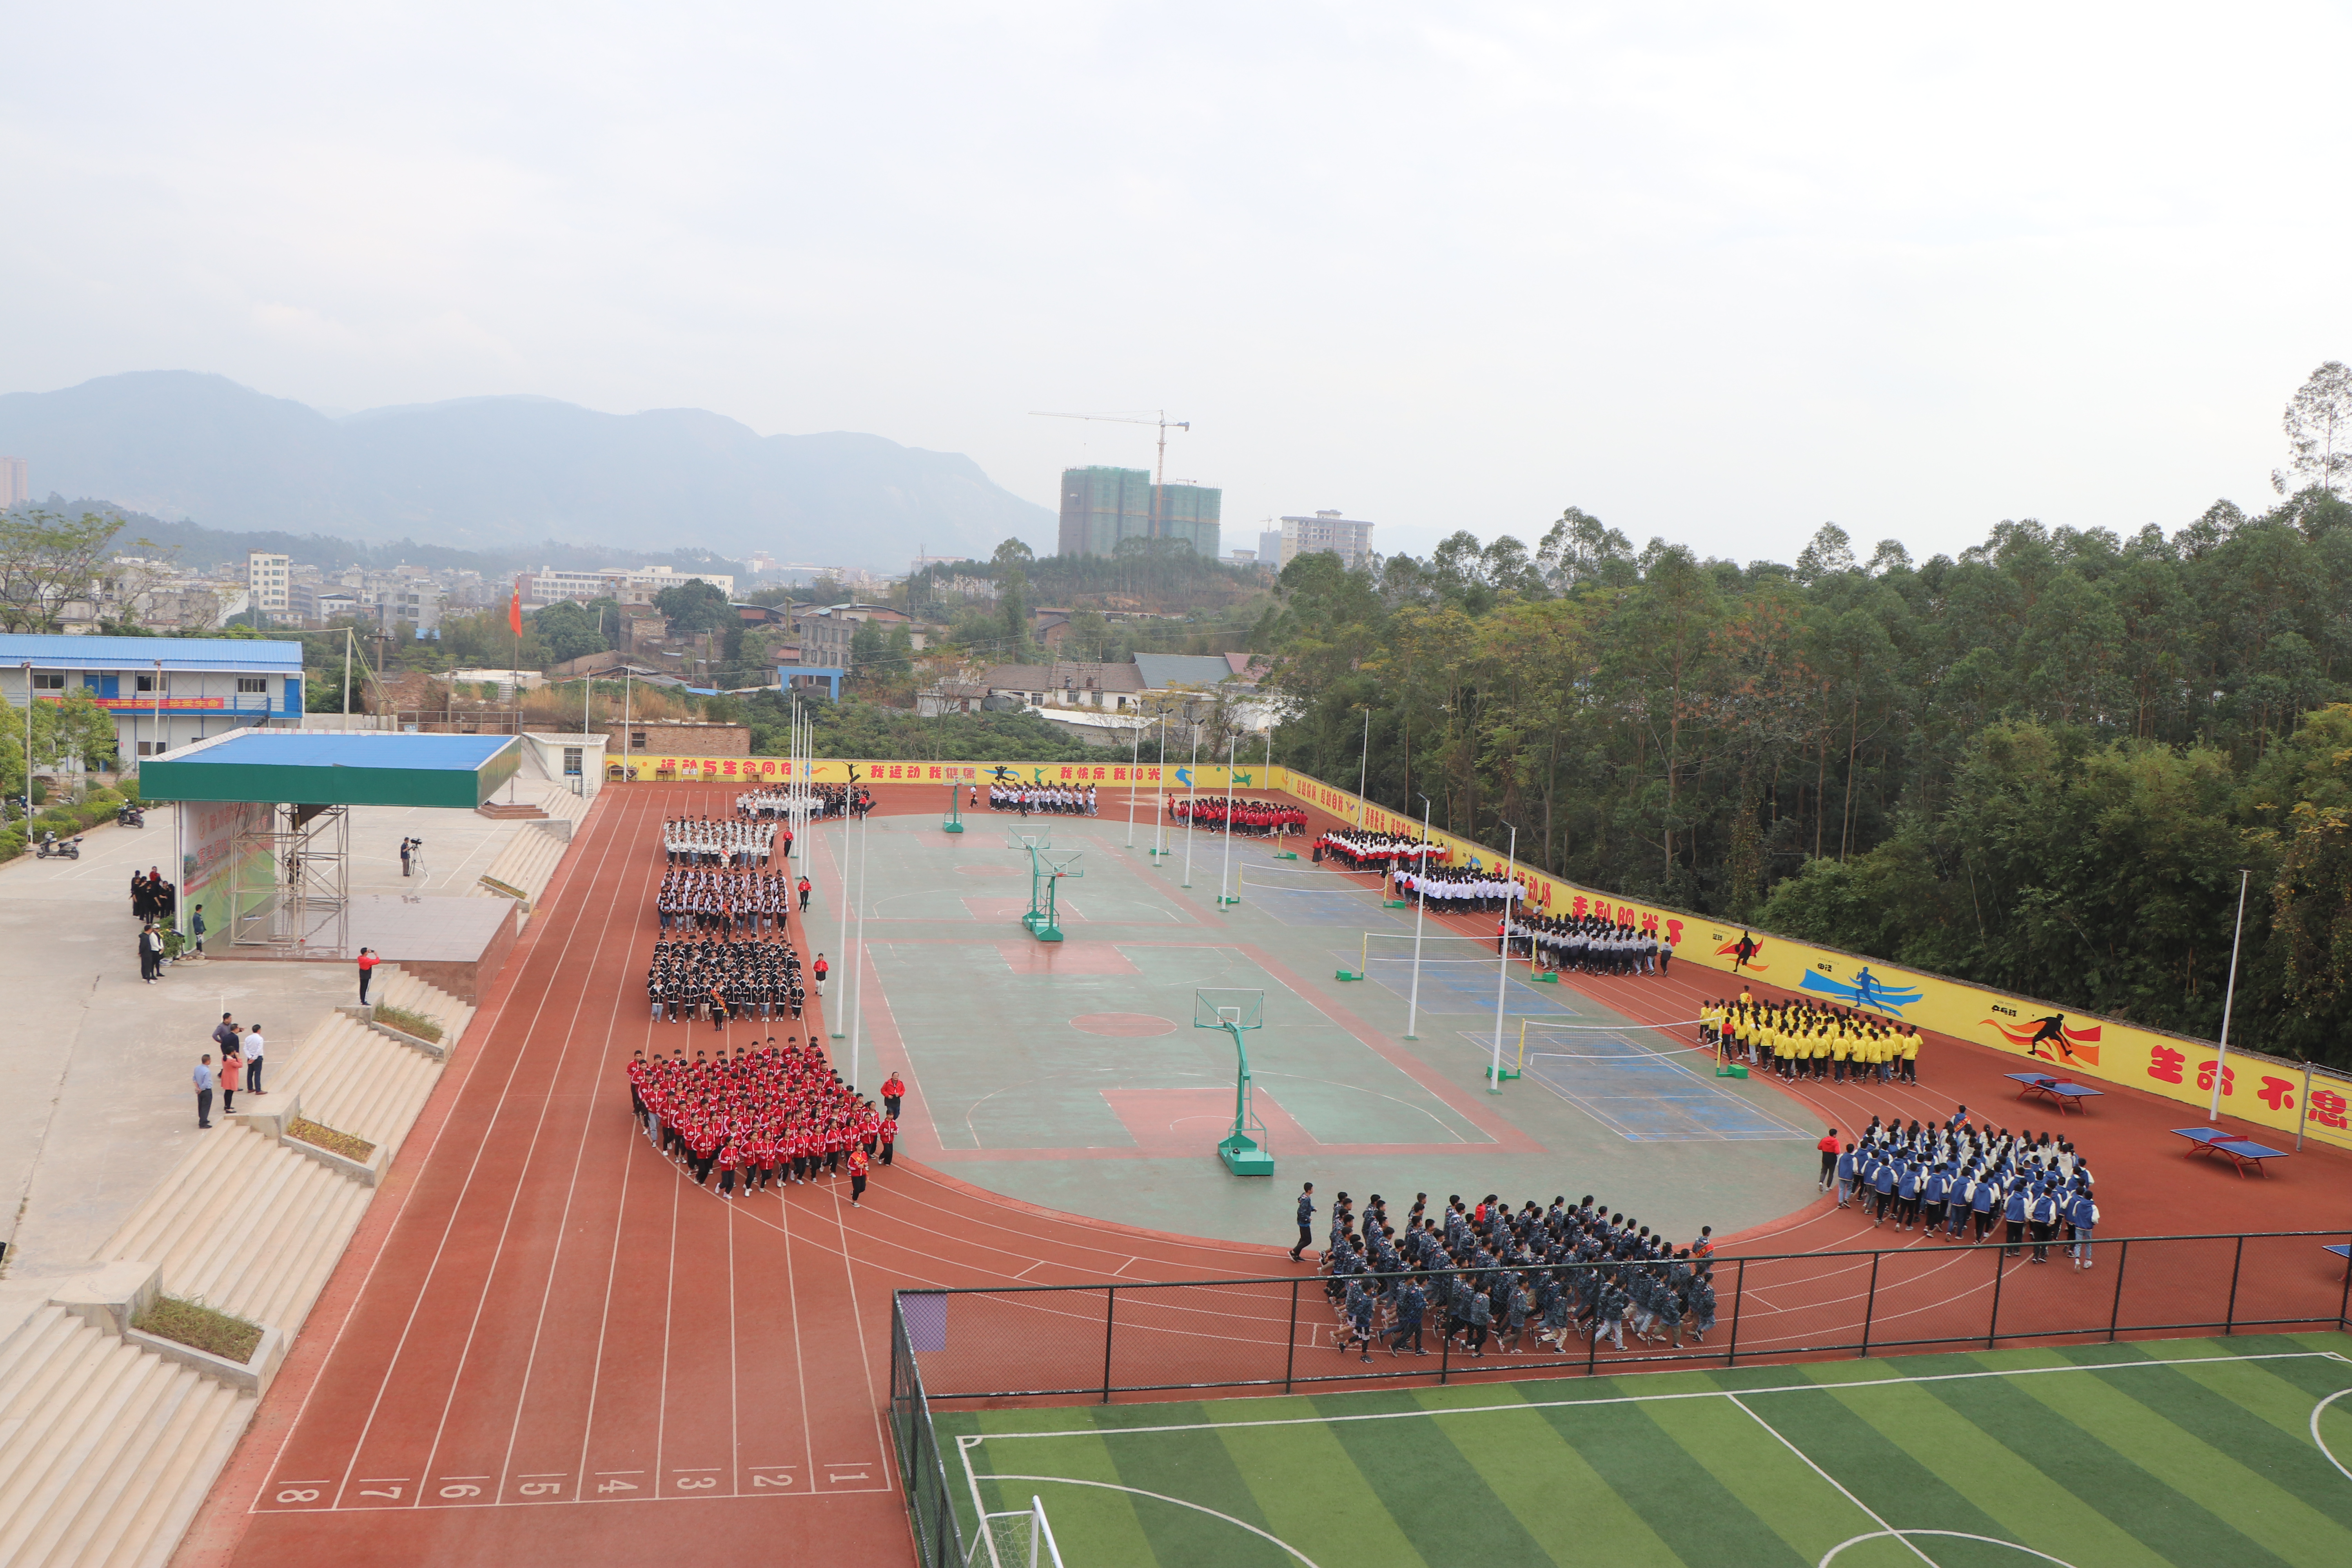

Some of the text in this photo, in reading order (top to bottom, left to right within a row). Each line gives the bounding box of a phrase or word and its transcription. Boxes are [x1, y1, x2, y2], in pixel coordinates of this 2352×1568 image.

[870, 765, 920, 778] 我运动
[1060, 767, 1105, 779] 我快乐
[1817, 963, 1832, 972] 田径
[2147, 1045, 2347, 1129] 生命不息
[677, 1477, 717, 1490] 3
[754, 1474, 793, 1487] 2
[829, 1472, 869, 1483] 1
[359, 1486, 402, 1499] 7
[439, 1485, 481, 1498] 6
[519, 1483, 560, 1495] 5
[598, 1479, 638, 1493] 4
[276, 1488, 319, 1503] 8
